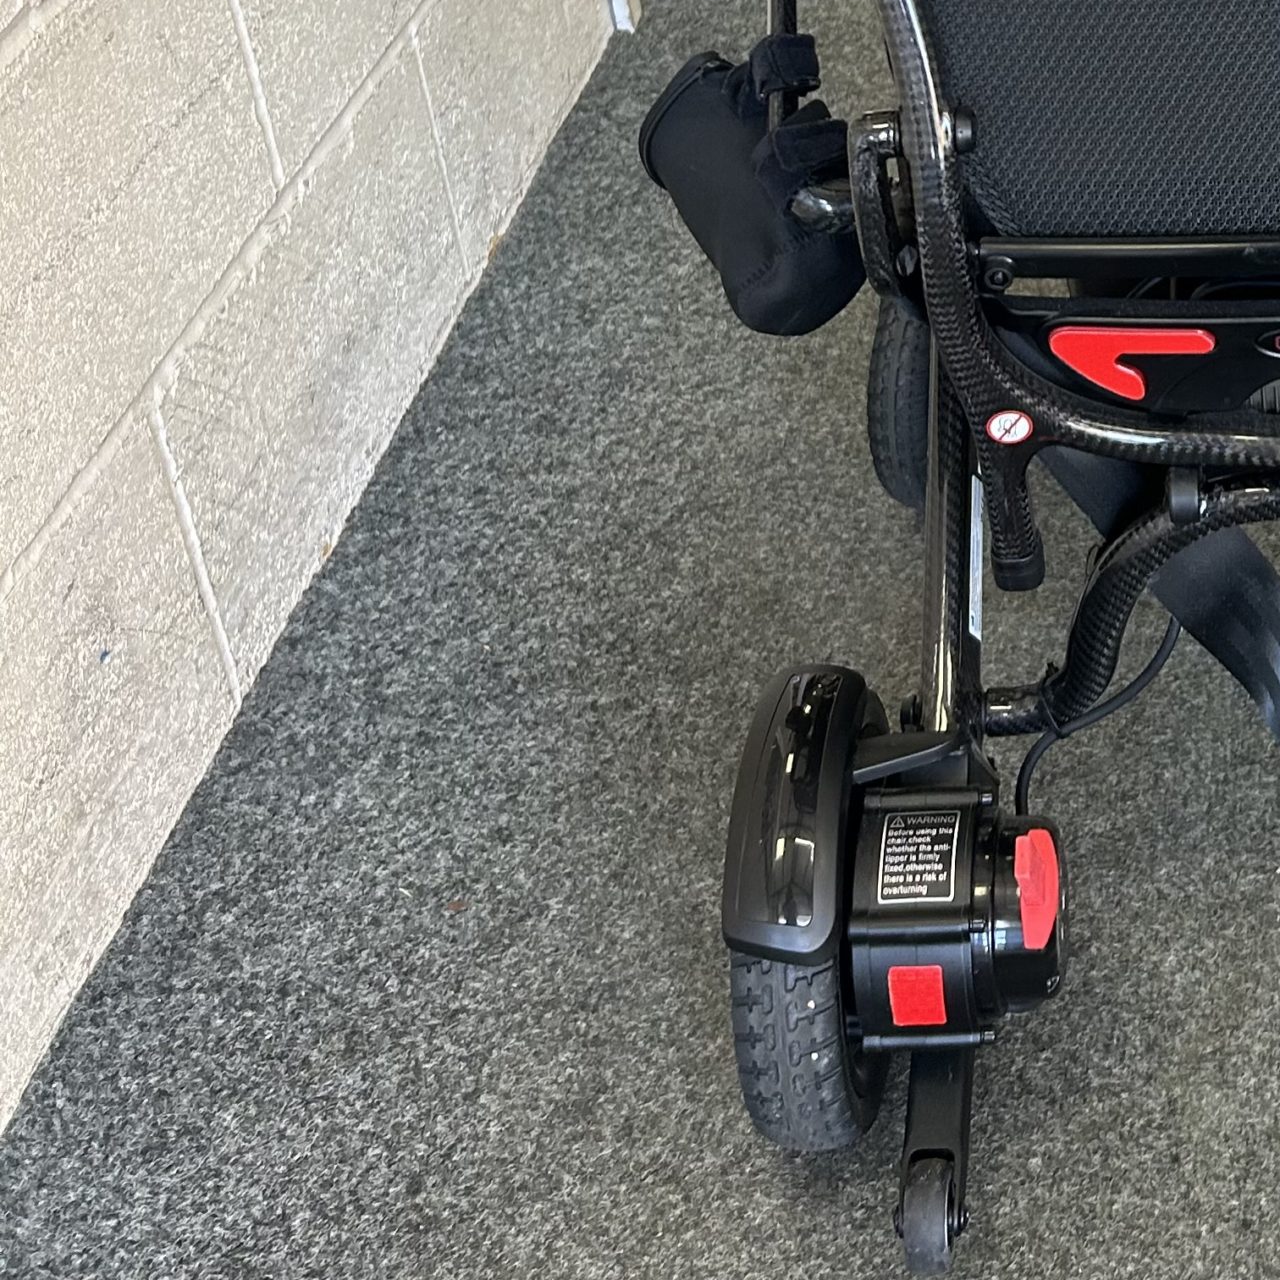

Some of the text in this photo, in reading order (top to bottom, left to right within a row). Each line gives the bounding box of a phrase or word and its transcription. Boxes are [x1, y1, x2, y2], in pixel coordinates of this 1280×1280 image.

[907, 815, 955, 824] WARNING
[888, 829, 914, 837] Before
[916, 828, 937, 836] using
[886, 845, 917, 854] whether
[919, 844, 932, 852] the
[909, 853, 917, 861] is
[919, 852, 940, 862] firmly
[883, 874, 904, 883] there
[906, 873, 913, 882] is
[922, 872, 937, 881] risk
[938, 871, 947, 881] of
[882, 883, 928, 896] overturning
